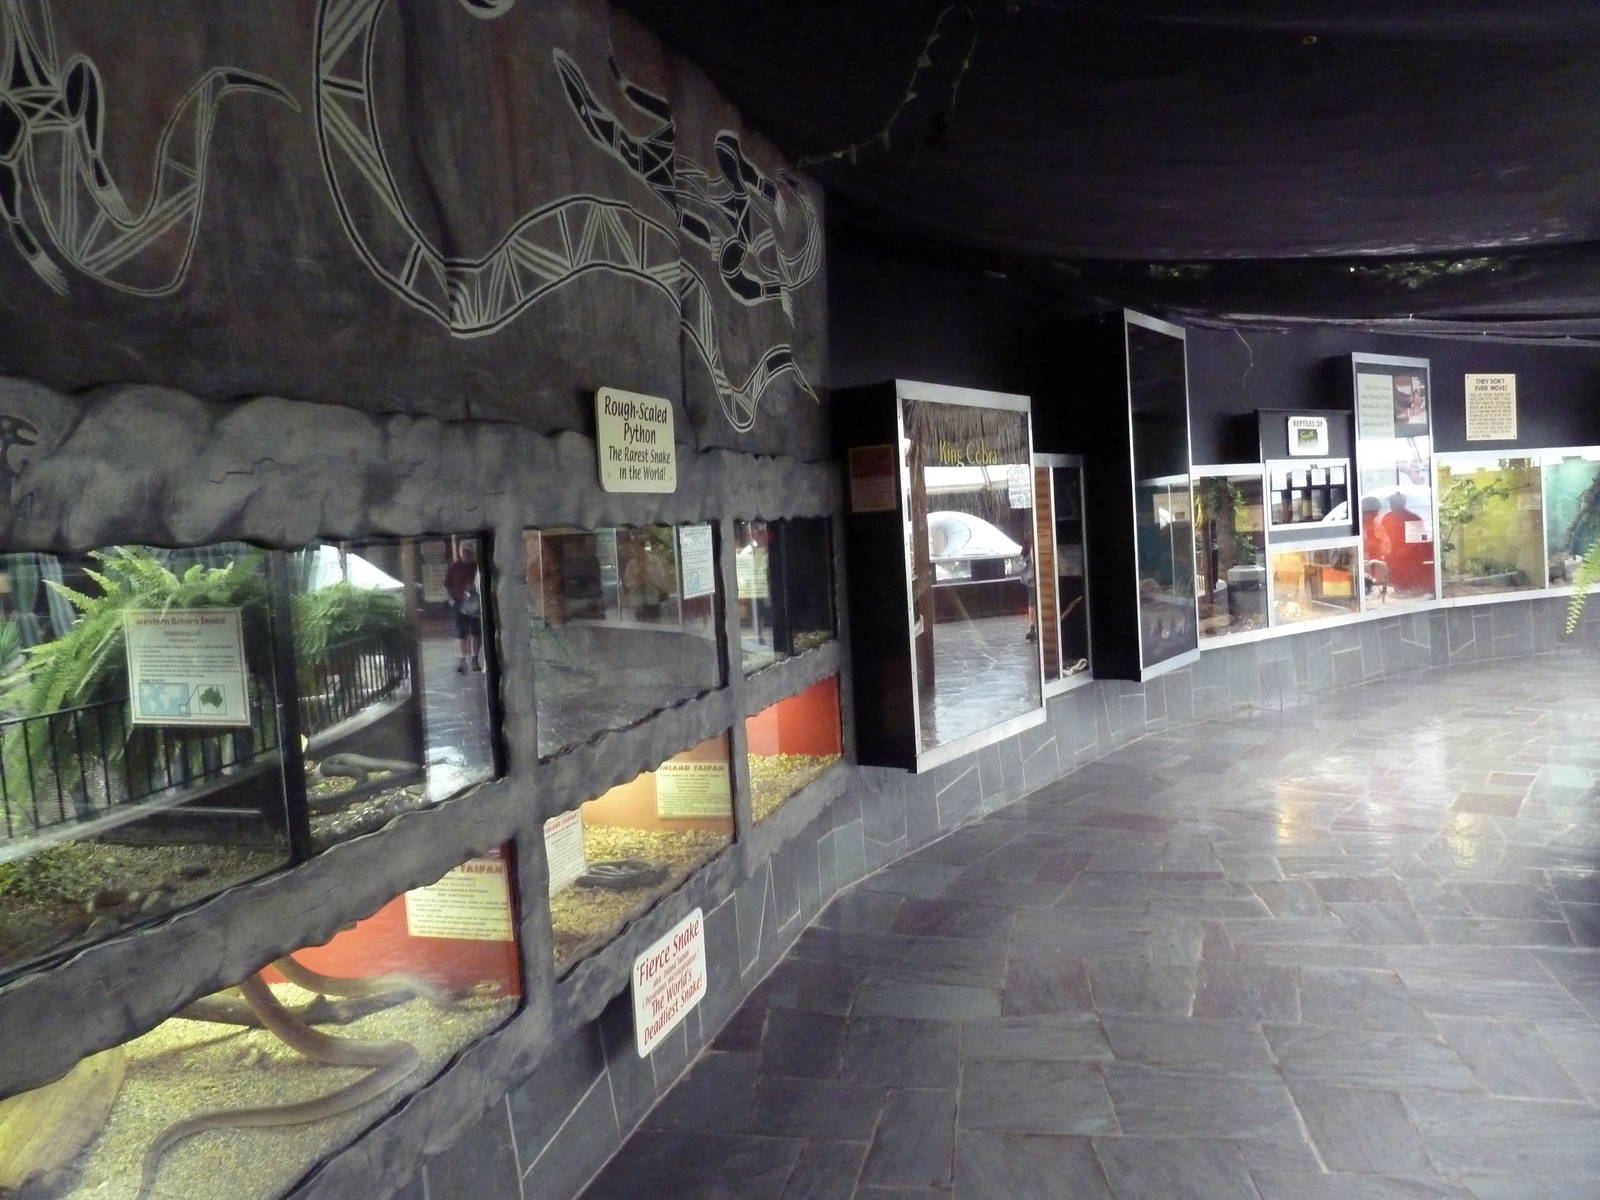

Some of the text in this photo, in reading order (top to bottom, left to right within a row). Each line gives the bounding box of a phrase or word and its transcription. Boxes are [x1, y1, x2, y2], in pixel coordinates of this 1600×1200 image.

[604, 395, 668, 424] Rough-Scaled
[623, 422, 656, 445] Python
[609, 445, 671, 464] The Rarest Snake
[939, 439, 998, 468] King Cobra
[629, 465, 642, 480] the
[643, 466, 666, 480] World!
[639, 945, 670, 986] Fierce
[673, 919, 700, 957] Snake
[651, 997, 665, 1017] The
[666, 971, 692, 1001] World's
[643, 1001, 679, 1046] Deadliest
[681, 972, 703, 1008] Snake!
